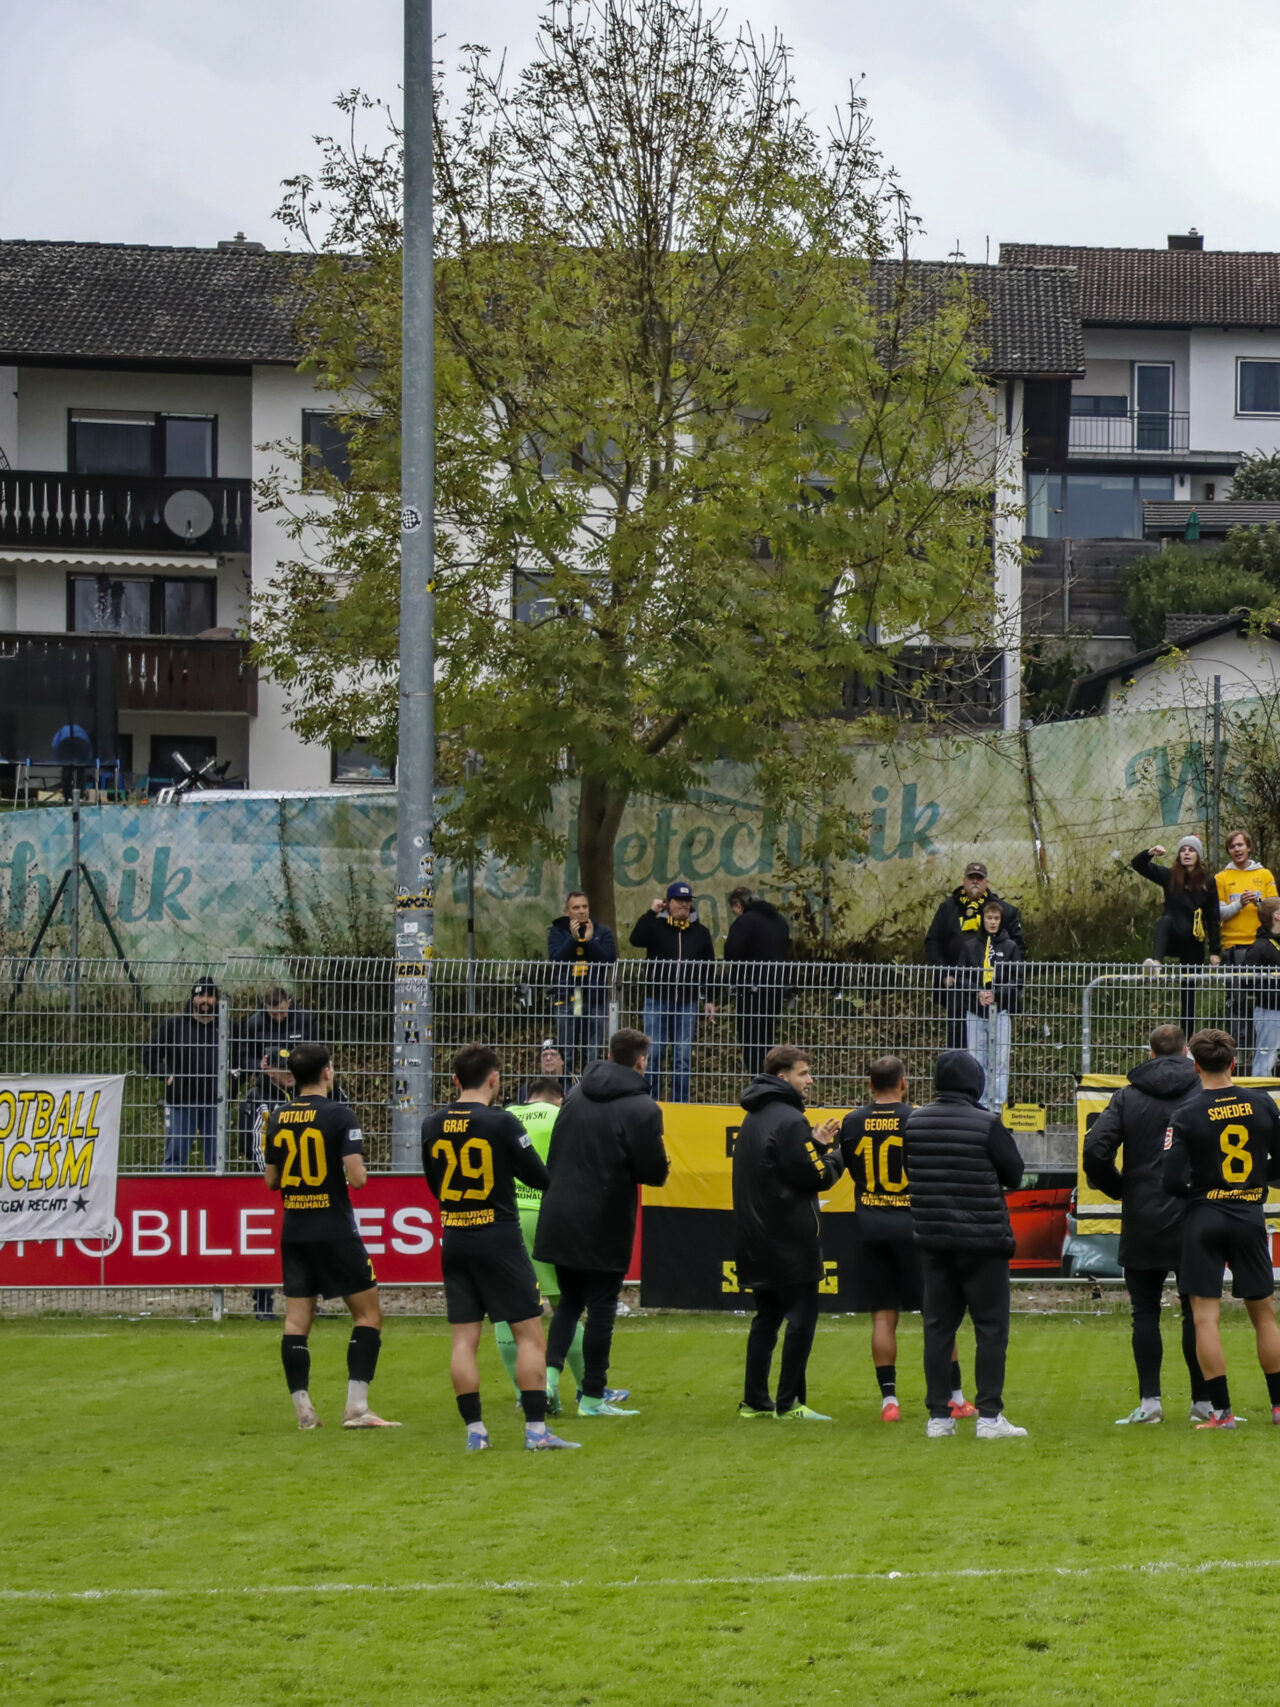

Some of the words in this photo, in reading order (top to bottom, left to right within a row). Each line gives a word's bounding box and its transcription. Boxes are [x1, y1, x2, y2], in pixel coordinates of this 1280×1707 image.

[278, 1110, 317, 1124] POTALOV
[1208, 1103, 1253, 1121] SCHEDER
[443, 1119, 470, 1133] GRAF
[864, 1118, 899, 1131] GEORGE
[273, 1127, 328, 1188] 20
[1220, 1124, 1253, 1183] 8
[432, 1138, 495, 1201] 29
[854, 1135, 909, 1193] 10
[27, 1197, 68, 1211] RECHTS
